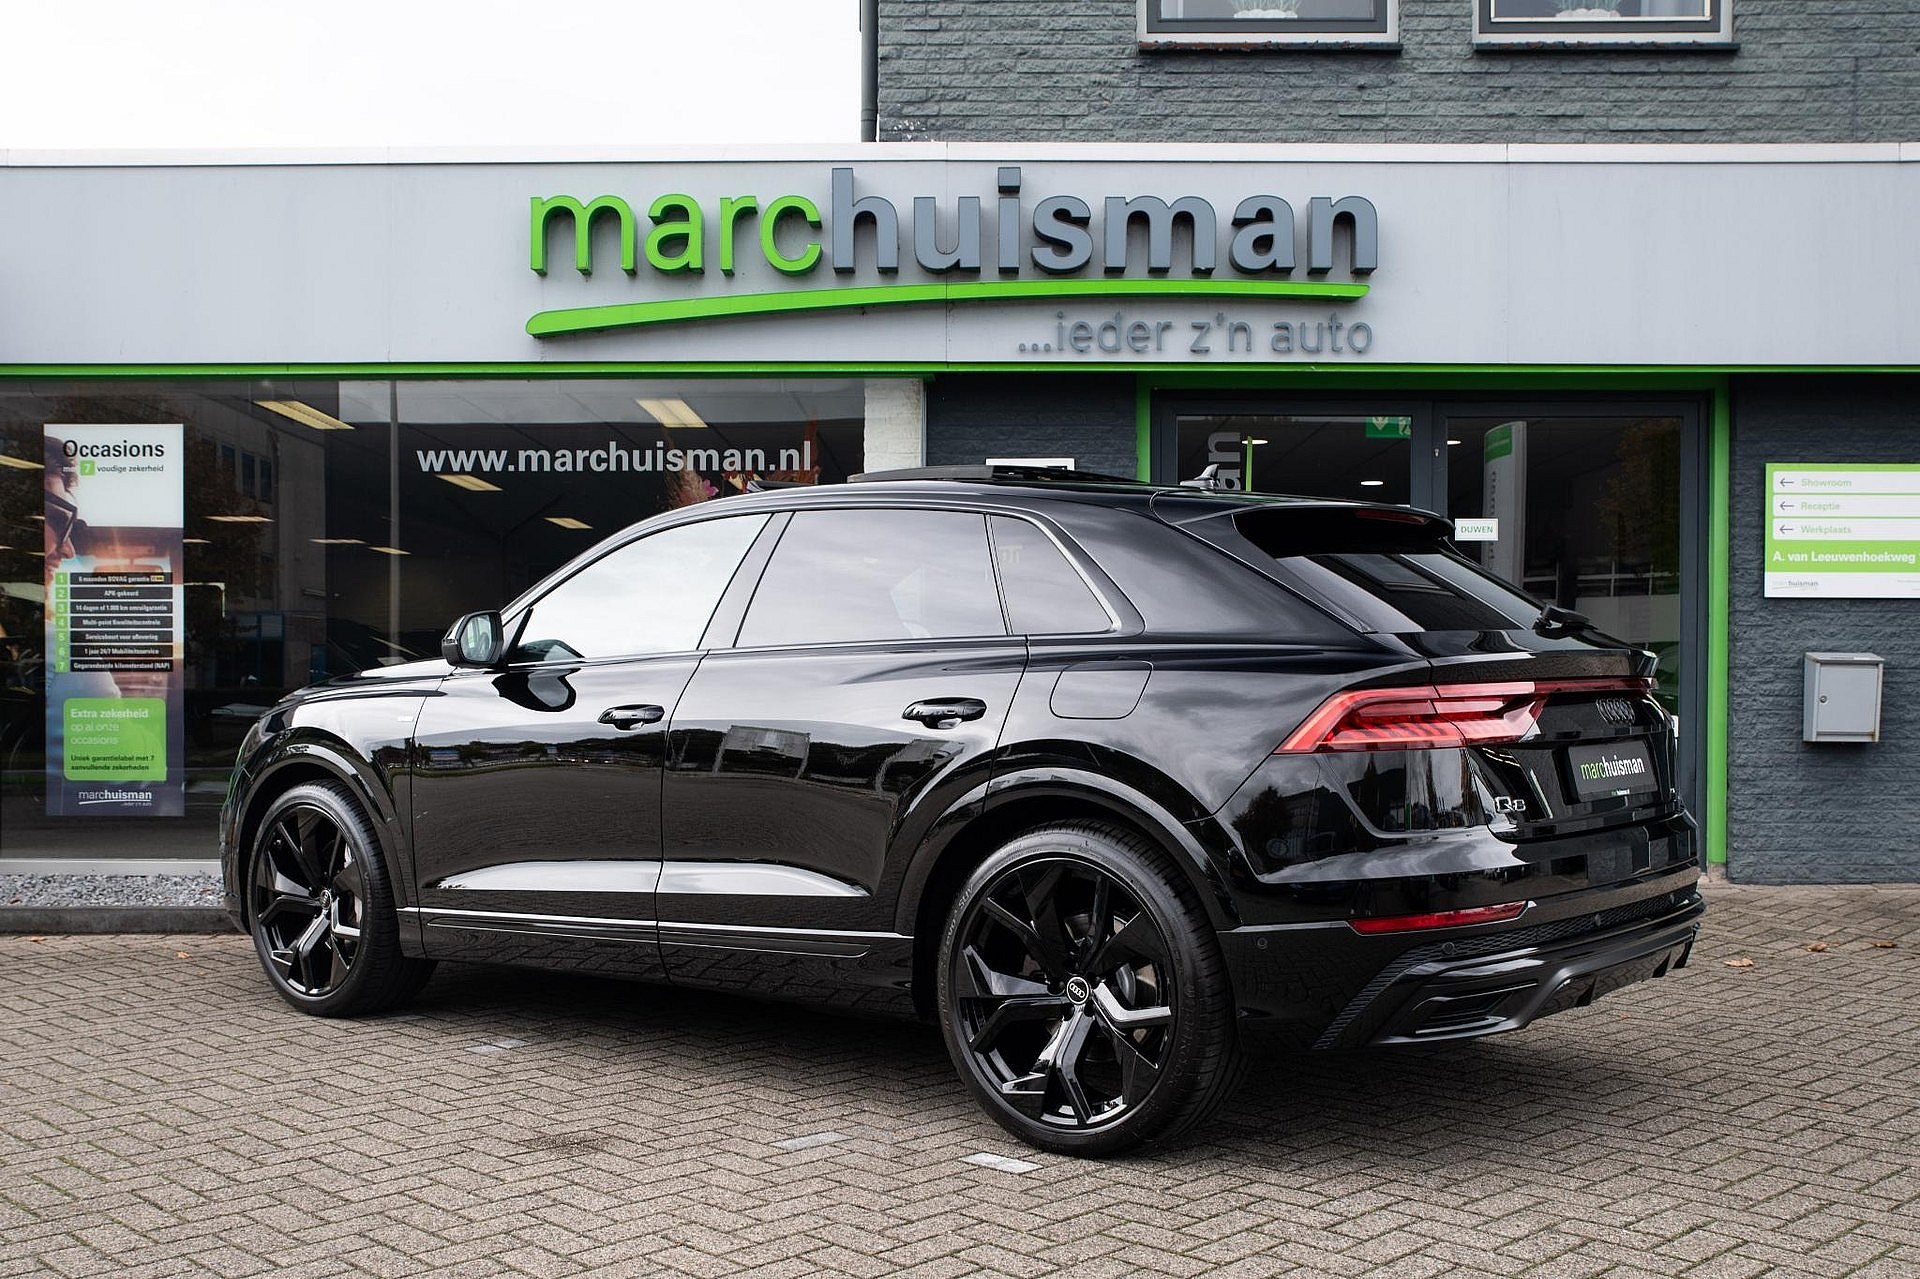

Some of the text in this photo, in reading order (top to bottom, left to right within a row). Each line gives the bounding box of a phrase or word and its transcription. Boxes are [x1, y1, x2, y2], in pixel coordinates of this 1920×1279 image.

[530, 167, 1381, 277] marchuisman
[1190, 313, 1252, 354] z'n
[1273, 313, 1375, 354] auto
[63, 440, 165, 458] Occasions
[417, 441, 812, 472] www.marchuisman.nl
[96, 464, 127, 474] voudige
[128, 463, 164, 473] zekerheid
[1801, 478, 1852, 488] Showroom
[1801, 501, 1840, 512] Receptie
[1460, 525, 1494, 534] DUWEN
[1800, 525, 1852, 536] Werkplaats
[1772, 551, 1785, 562] A.
[1787, 553, 1808, 562] van
[1811, 551, 1916, 564] Leeuwenhoekweg
[70, 708, 149, 719] Extra zekerheid
[70, 723, 84, 732] op
[85, 721, 94, 731] al
[70, 735, 119, 745] occasions
[1580, 754, 1645, 780] marchuisman
[78, 789, 152, 800] marchuisman
